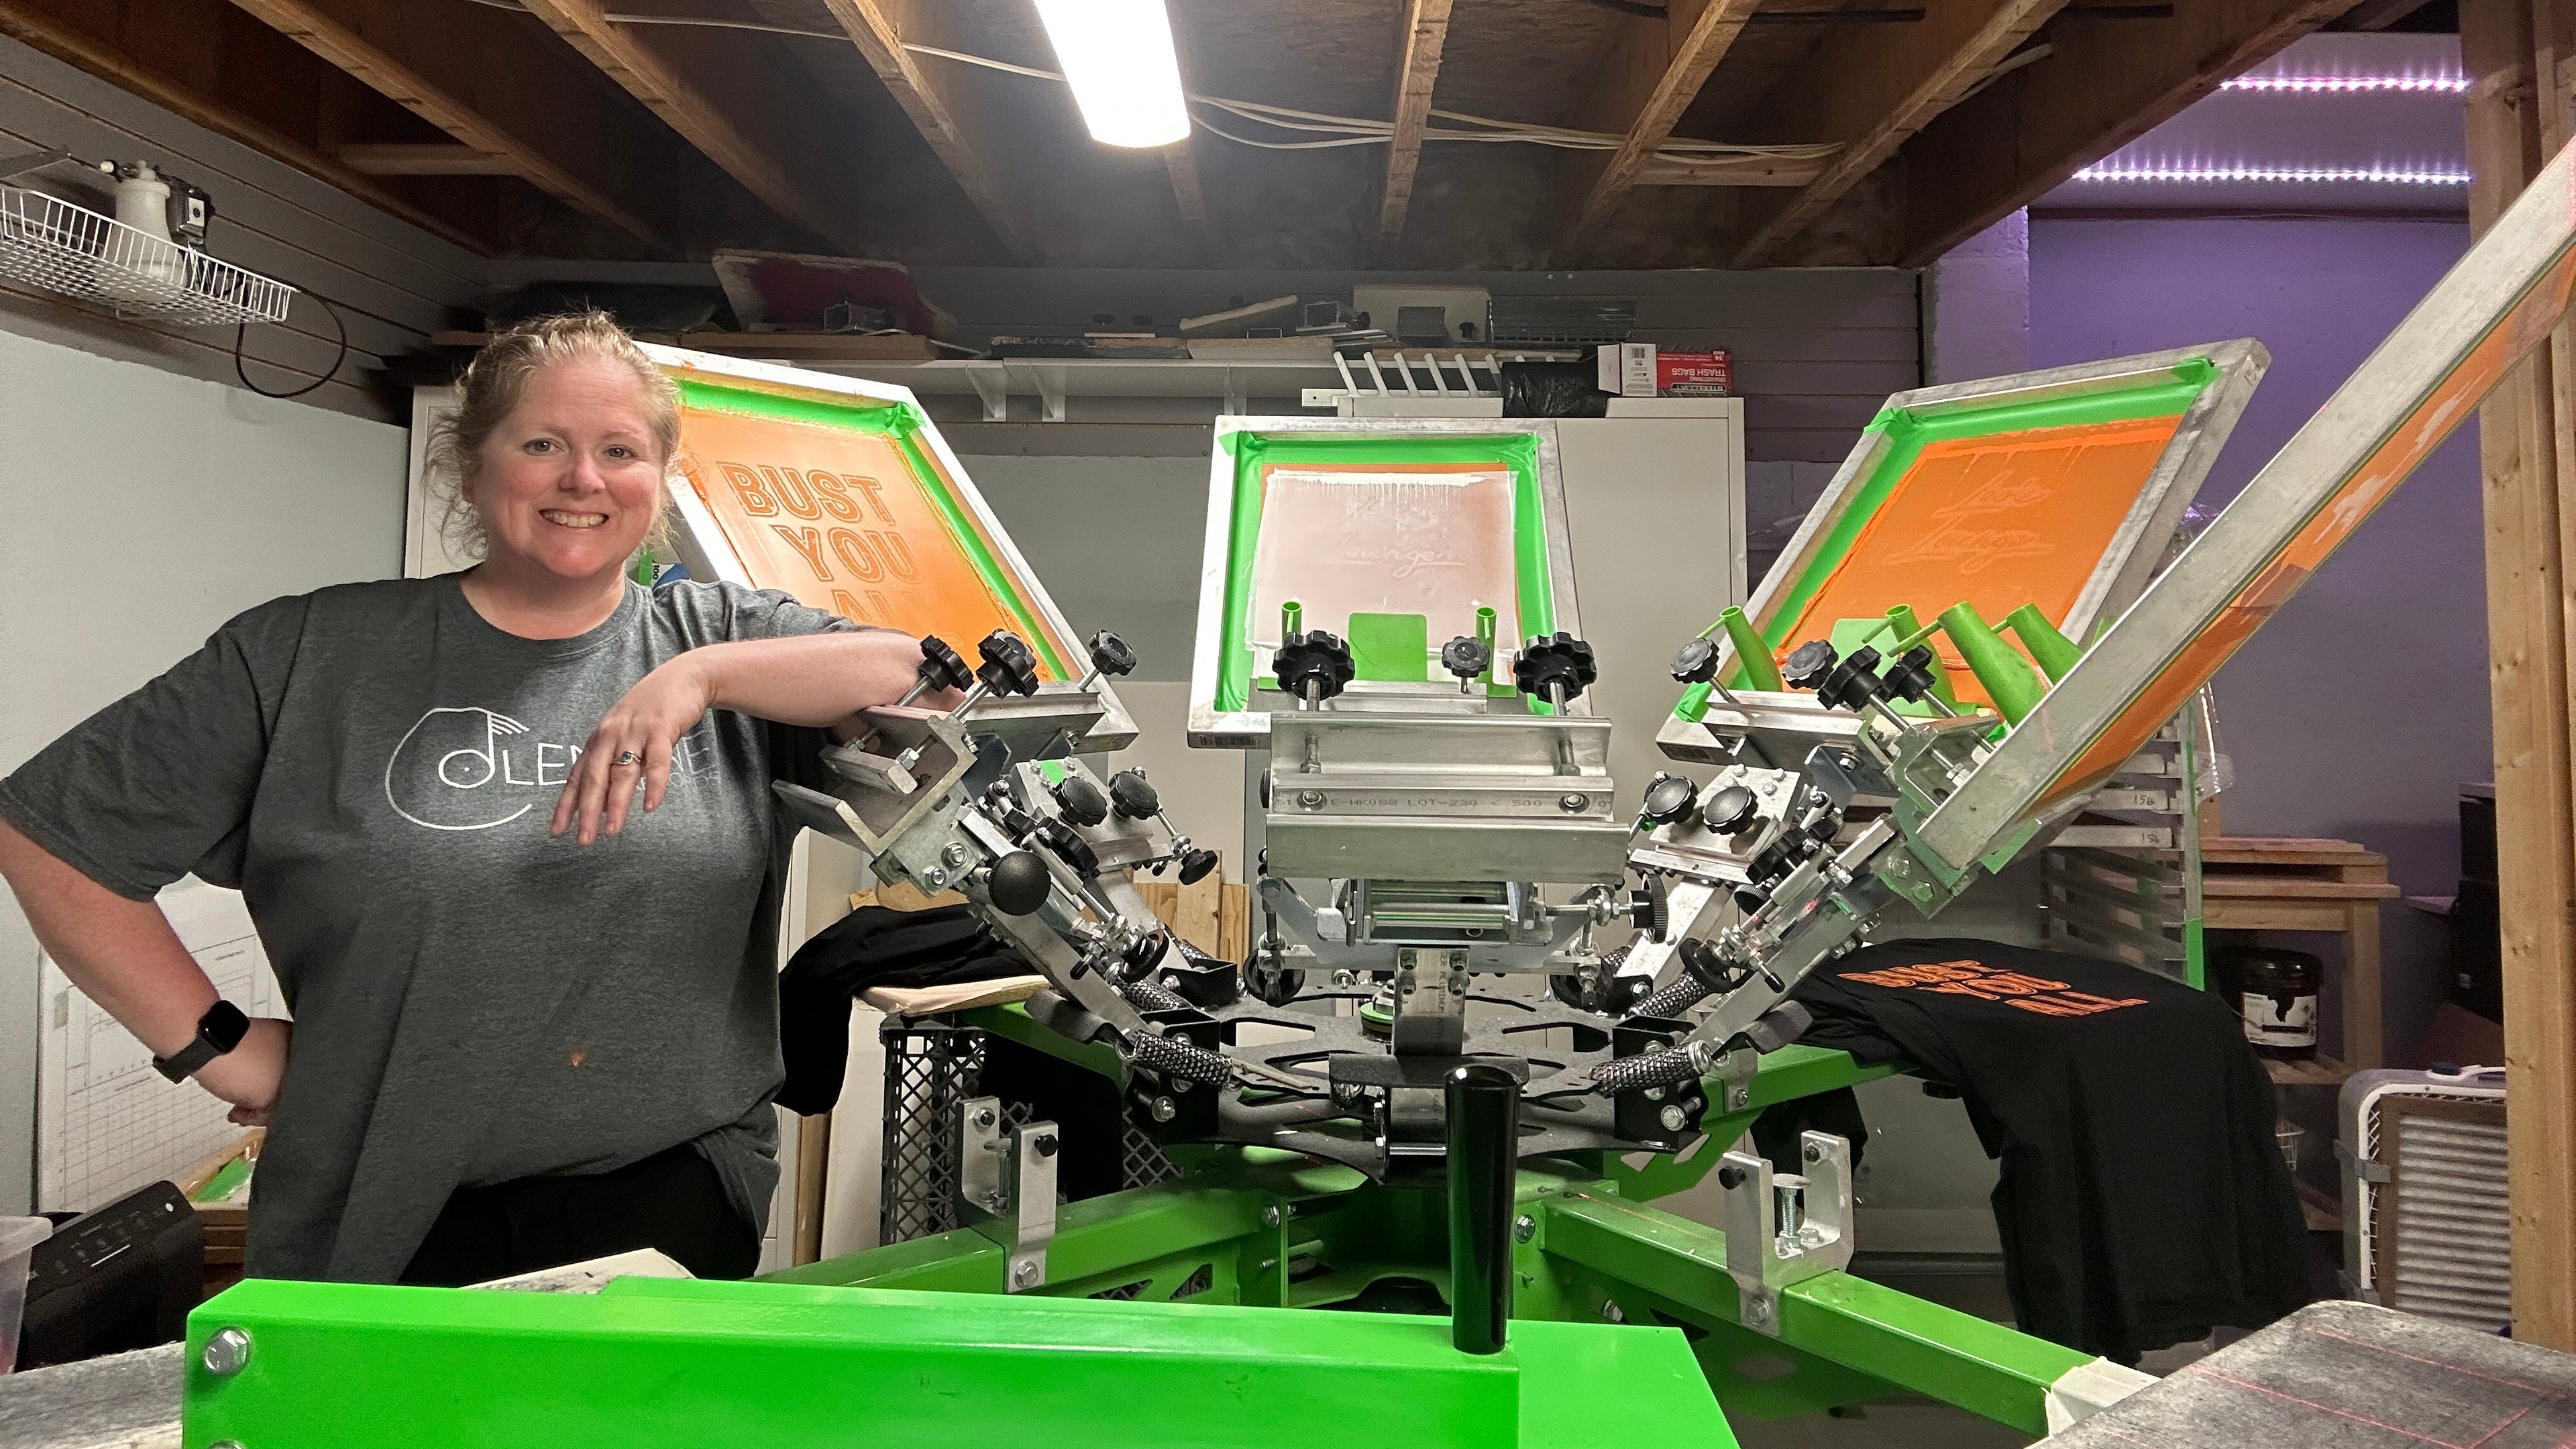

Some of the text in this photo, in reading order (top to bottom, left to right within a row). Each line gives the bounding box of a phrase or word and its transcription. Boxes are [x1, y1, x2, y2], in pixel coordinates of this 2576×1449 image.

[1672, 368, 1726, 376] TRASH BAGS
[716, 461, 896, 527] BUST
[769, 525, 925, 584] YOU
[1917, 973, 2071, 1000] YOU
